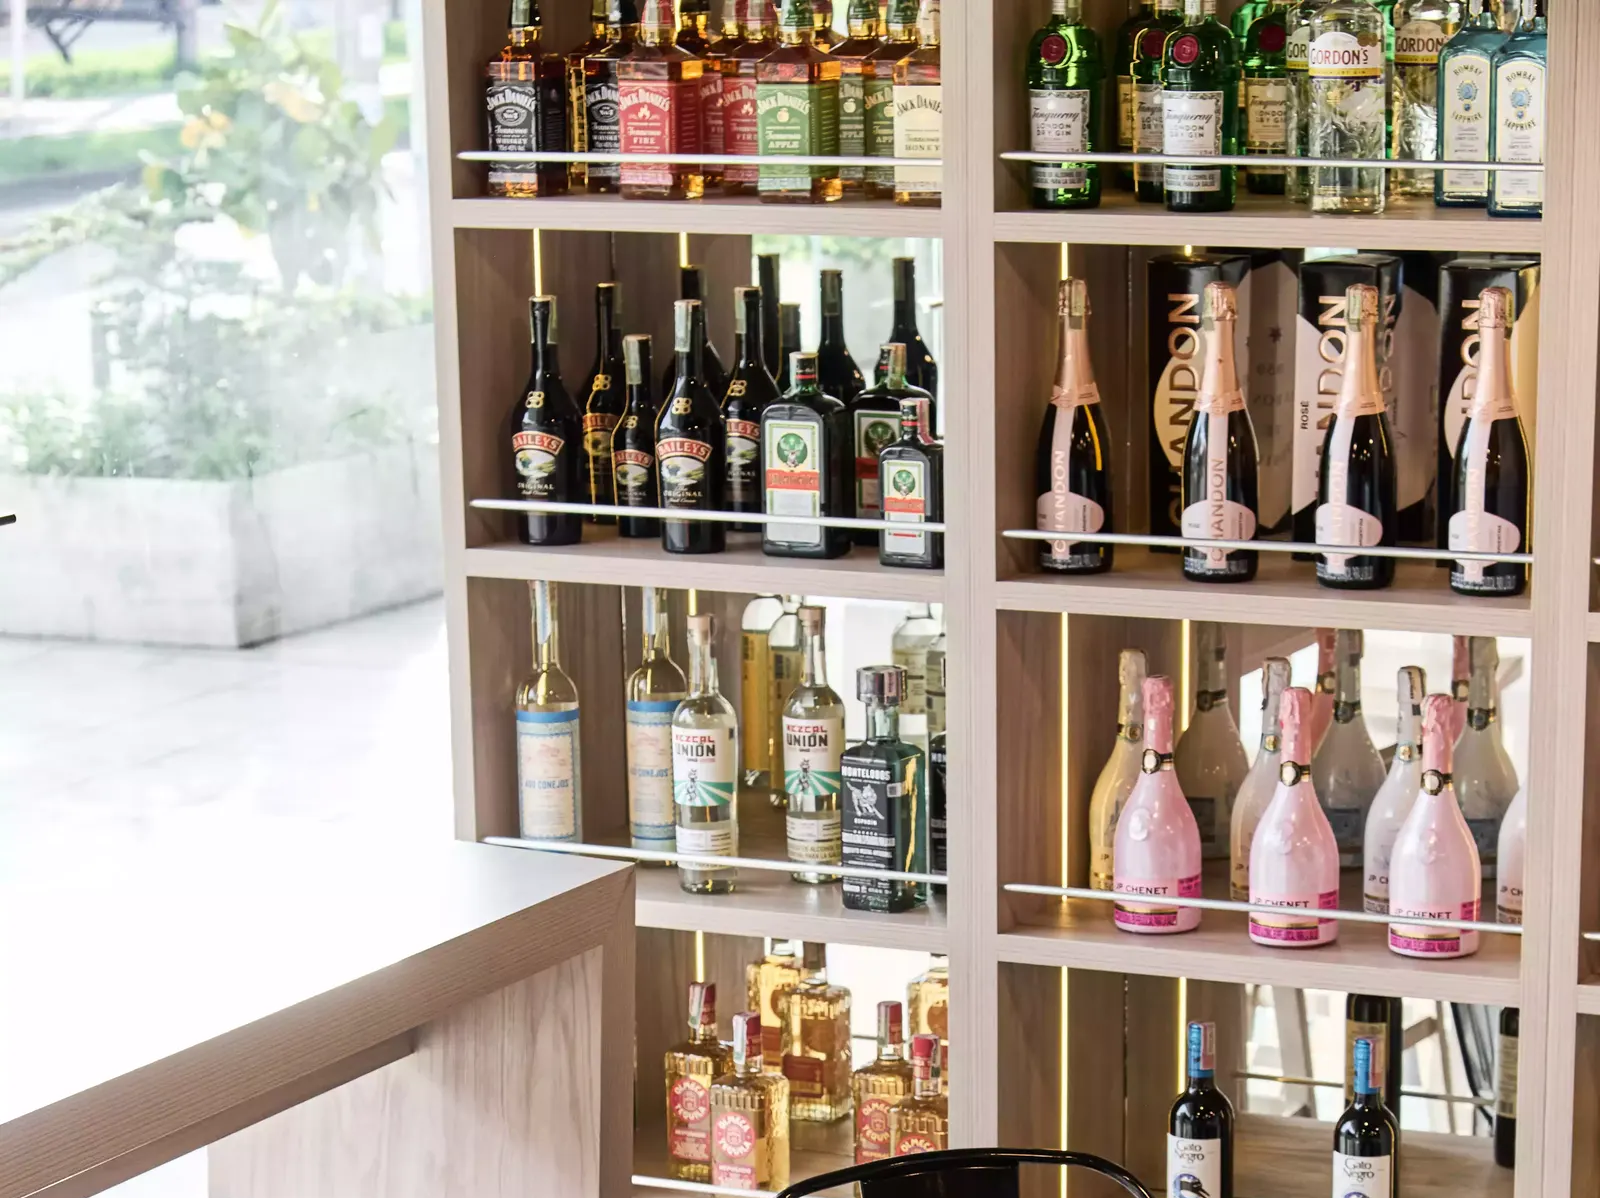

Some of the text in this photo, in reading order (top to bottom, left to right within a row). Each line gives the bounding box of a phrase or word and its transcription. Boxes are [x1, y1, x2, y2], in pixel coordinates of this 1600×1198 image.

[1310, 47, 1369, 65] GORDON'S
[1452, 64, 1484, 77] BOMBAY
[1505, 70, 1536, 83] BOMBAY
[896, 99, 916, 117] JACK
[1031, 106, 1080, 123] Tanqueray
[1450, 111, 1484, 125] SAPPHIRE
[1504, 118, 1537, 131] SAPPHIRE
[1036, 122, 1072, 130] LONDON
[1036, 129, 1072, 137] DRY GIN
[633, 136, 656, 144] FIRE
[767, 141, 800, 149] APPLE
[875, 136, 894, 144] APP
[905, 144, 941, 152] HONEY
[513, 433, 559, 450] BAILEYS
[658, 440, 708, 456] BAILEYS
[663, 489, 703, 497] ORIGINAL
[786, 733, 829, 747] UNIÓN
[638, 768, 669, 778] CONEJOS
[537, 779, 570, 790] CONEJOS
[1125, 885, 1169, 895] CHENET
[1406, 910, 1452, 920] CHENET
[718, 1114, 751, 1133] OLMECA
[1176, 1140, 1202, 1152] Gato
[1174, 1148, 1205, 1164] Negro
[1344, 1157, 1373, 1170] Gato
[1343, 1167, 1375, 1183] Negro
